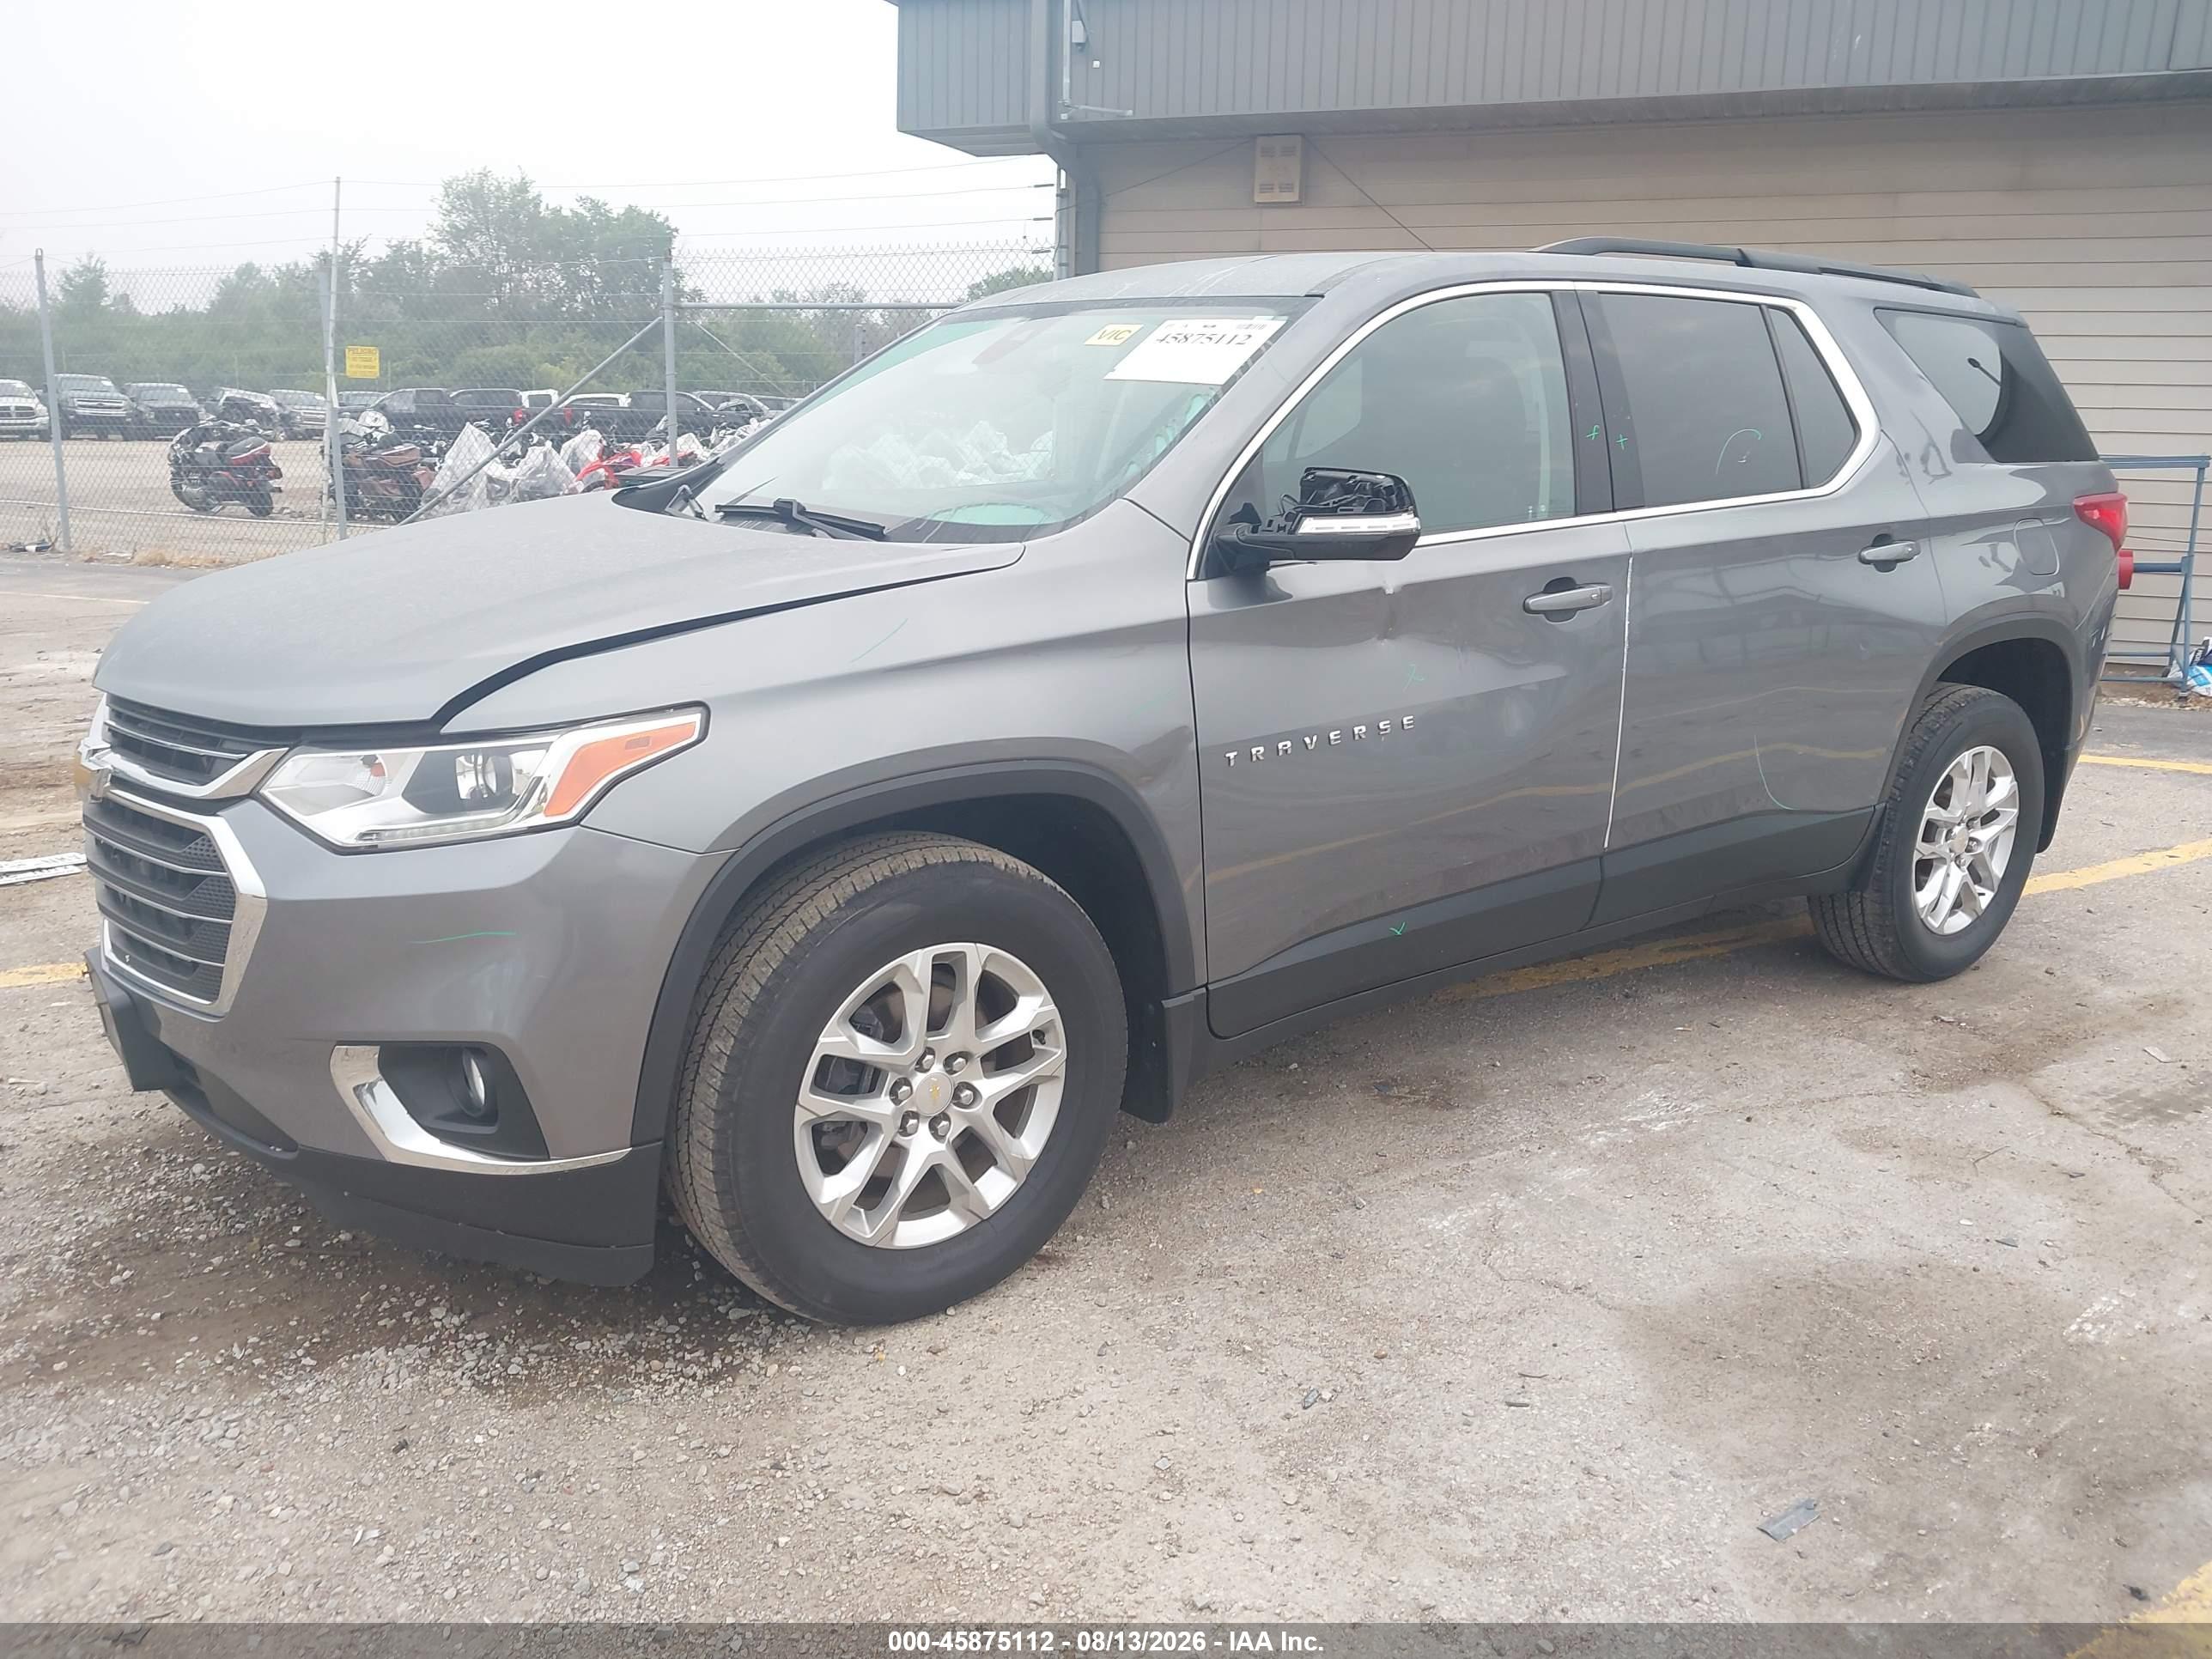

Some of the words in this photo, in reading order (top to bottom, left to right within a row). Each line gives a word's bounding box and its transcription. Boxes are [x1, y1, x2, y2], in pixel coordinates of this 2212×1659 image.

[1097, 329, 1132, 340] VIC
[1157, 332, 1253, 345] 45875112
[1224, 715, 1414, 767] TRAVERSE
